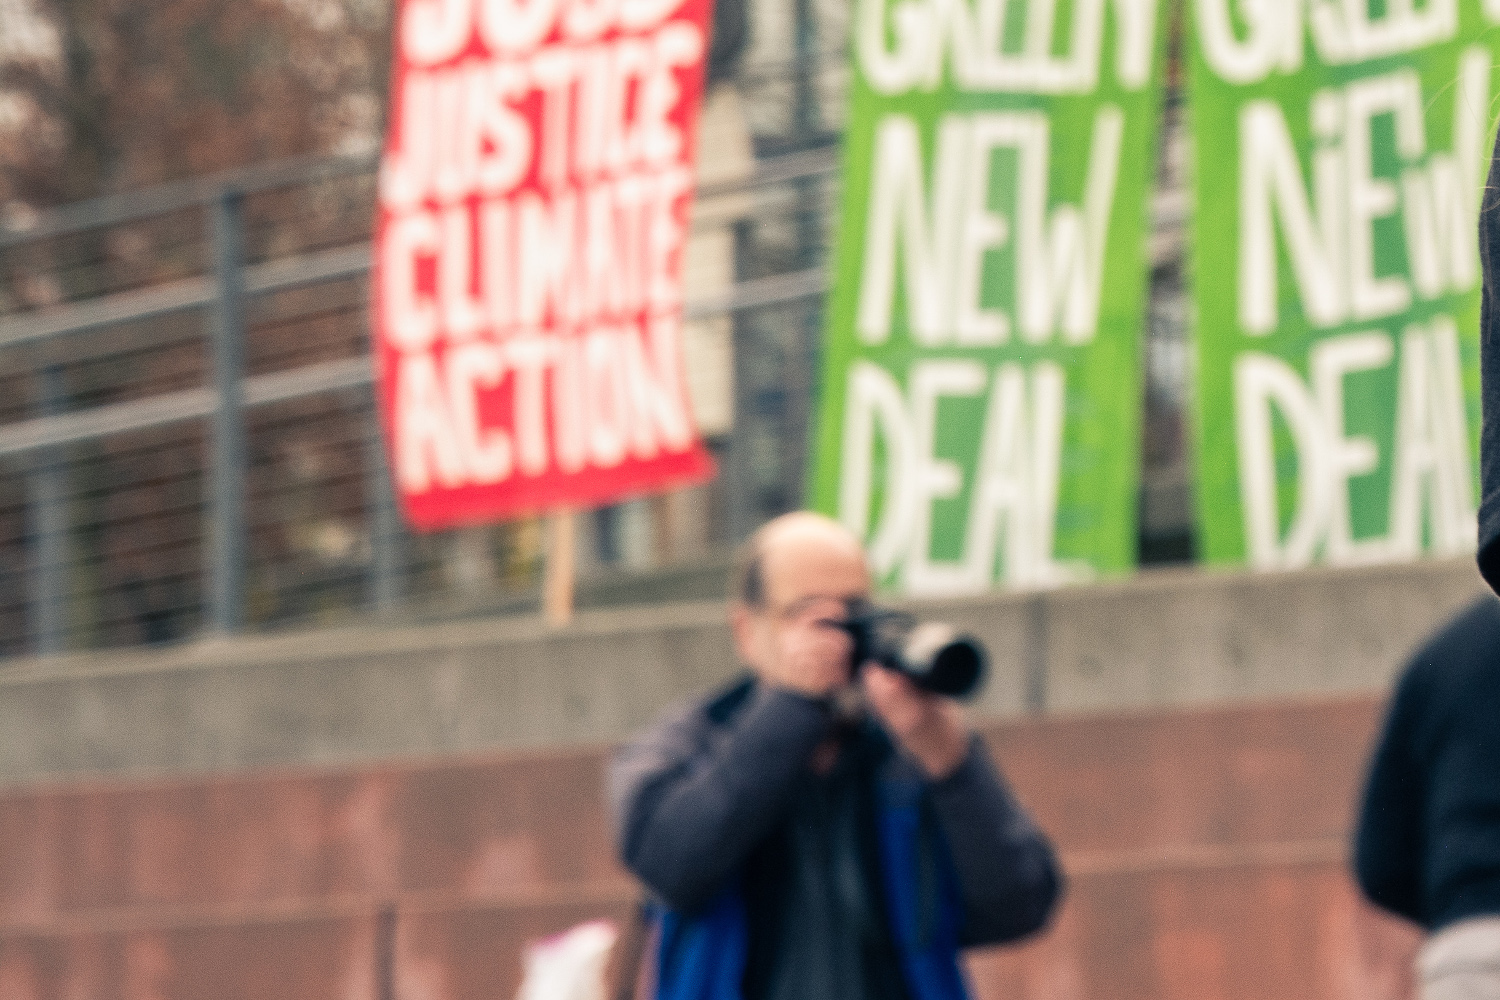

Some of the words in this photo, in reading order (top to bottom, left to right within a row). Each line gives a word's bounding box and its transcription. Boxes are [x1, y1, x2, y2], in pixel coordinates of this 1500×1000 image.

[380, 20, 703, 213] JUSTICE
[1237, 43, 1491, 337] NEW
[385, 166, 695, 351] CLIMATE
[857, 104, 1123, 347] NEW
[396, 313, 698, 495] ACTION
[840, 359, 1098, 595] DEAL
